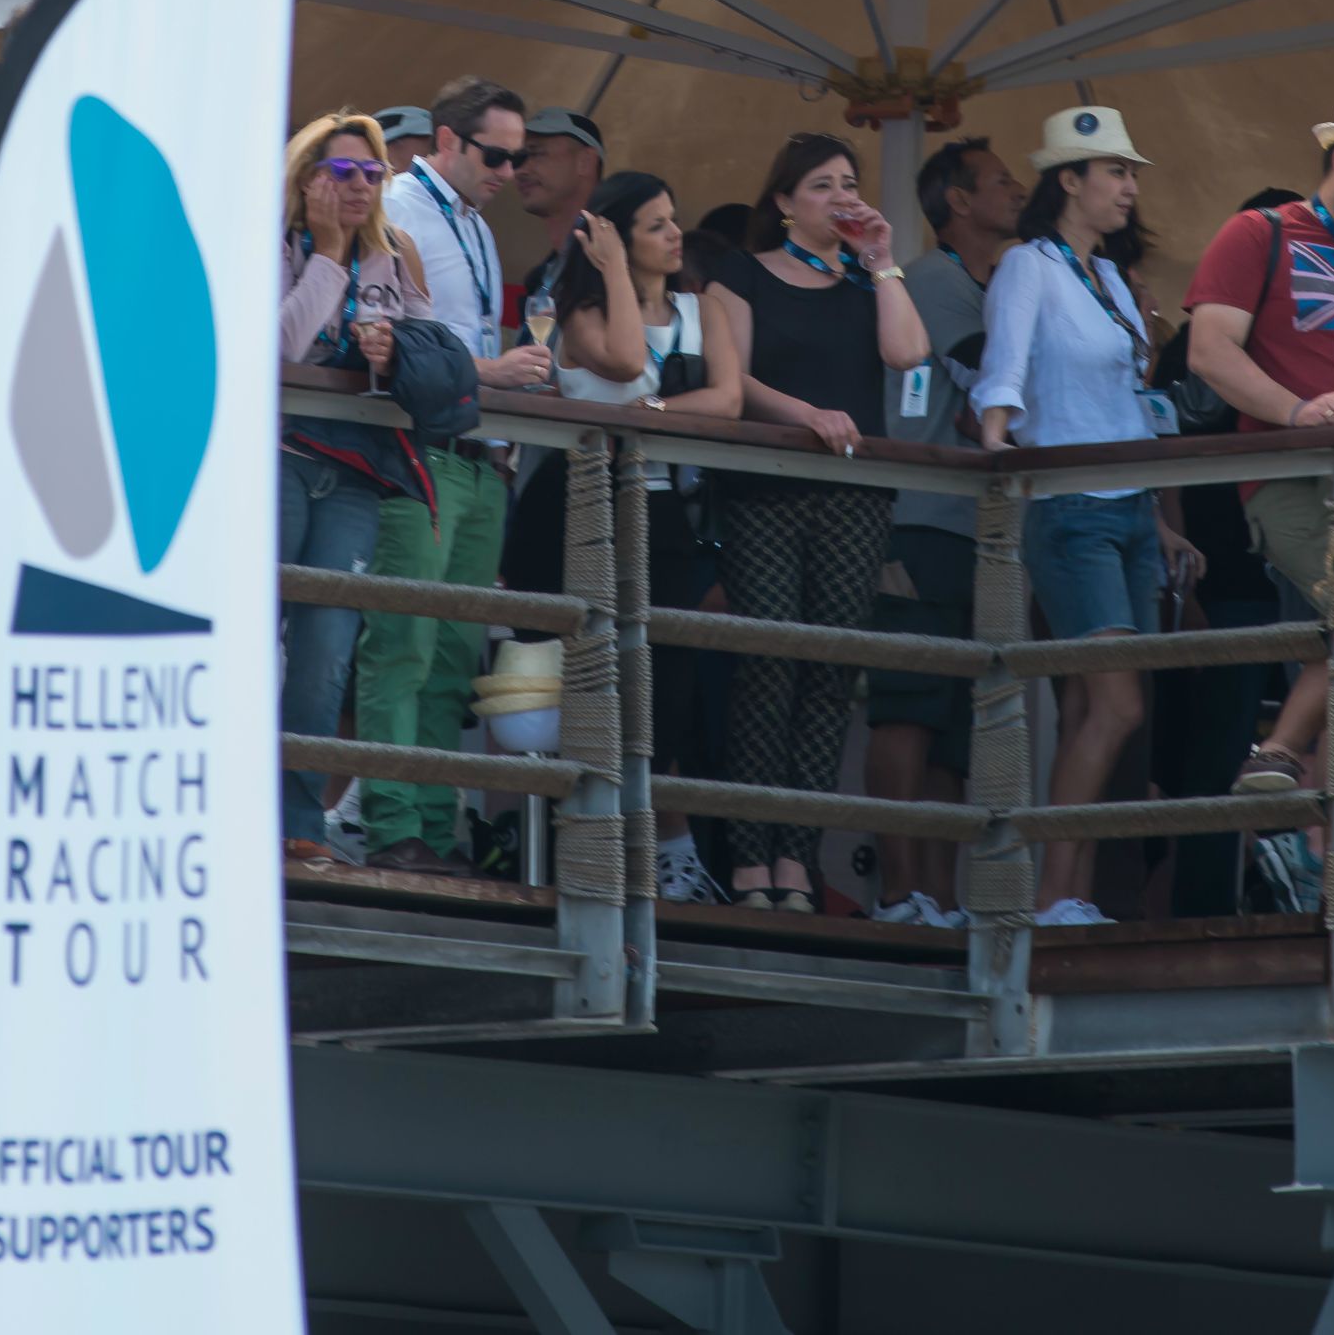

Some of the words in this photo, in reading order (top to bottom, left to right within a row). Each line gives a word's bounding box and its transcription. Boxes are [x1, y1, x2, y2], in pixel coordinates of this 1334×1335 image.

[11, 662, 208, 730] HELLENIC
[8, 751, 206, 817] MATCH
[7, 832, 207, 903] RACING
[3, 918, 209, 987] TOUR
[129, 1129, 231, 1181] TOUR
